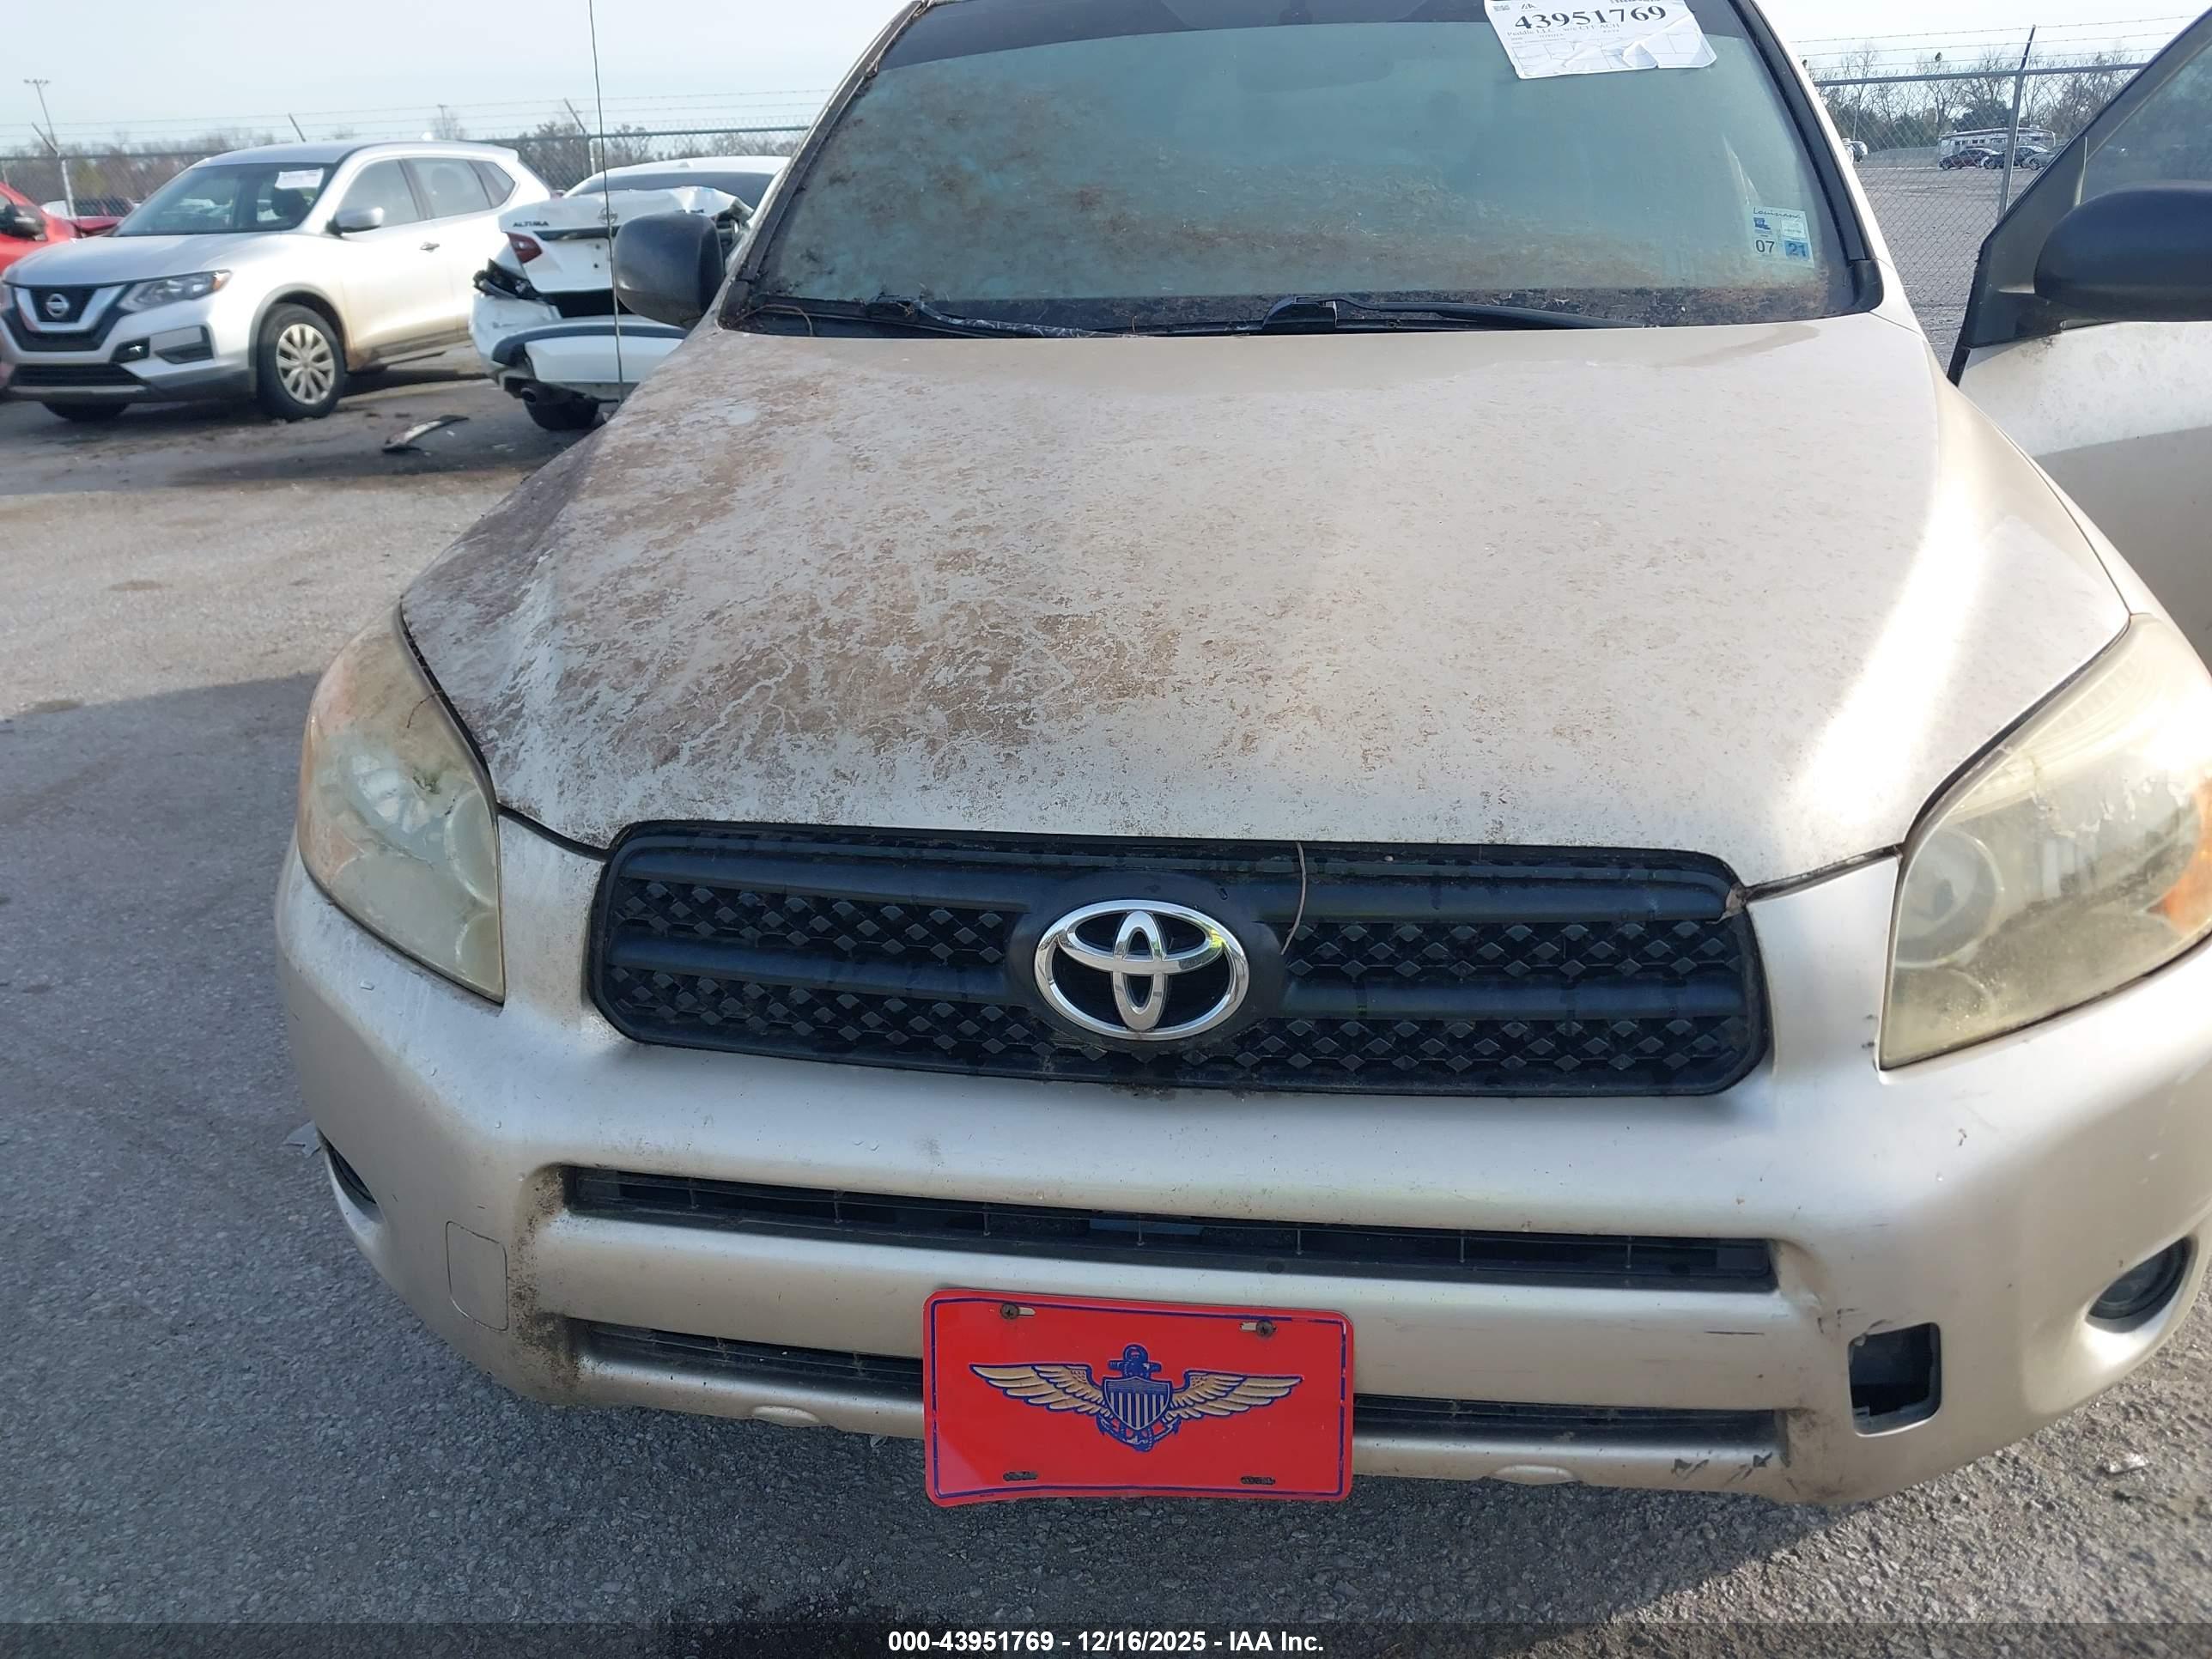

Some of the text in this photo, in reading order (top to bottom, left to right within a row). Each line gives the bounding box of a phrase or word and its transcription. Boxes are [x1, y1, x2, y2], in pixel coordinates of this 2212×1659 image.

[1515, 5, 1666, 29] 43951769
[1756, 240, 1774, 253] 07
[1789, 242, 1806, 257] 21
